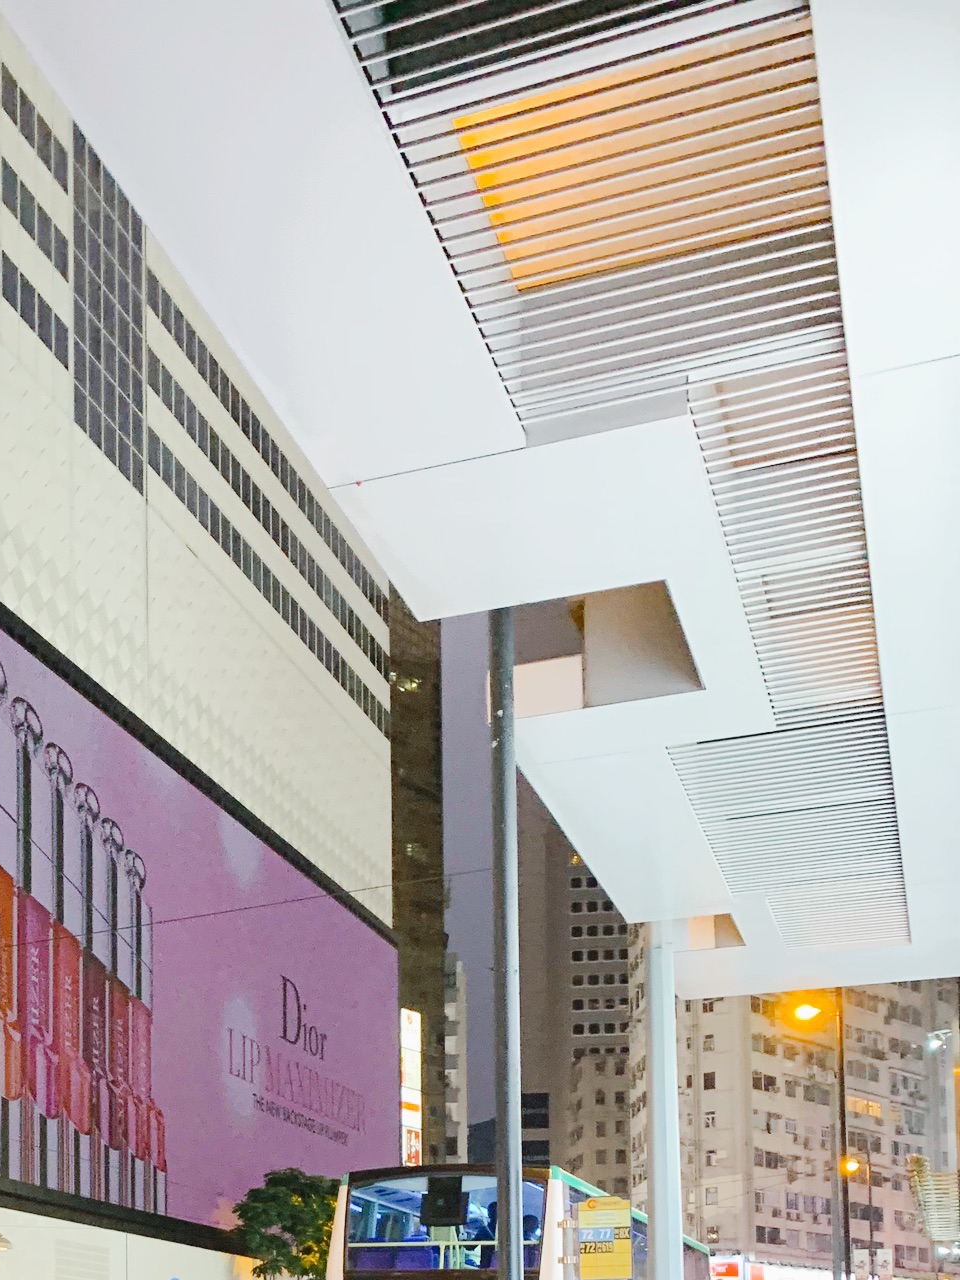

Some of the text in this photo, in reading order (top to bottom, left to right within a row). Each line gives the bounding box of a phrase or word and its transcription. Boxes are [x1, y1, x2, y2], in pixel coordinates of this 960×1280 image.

[280, 974, 328, 1060] Dior
[227, 1027, 367, 1135] LIP MAXIMIZER
[252, 1092, 265, 1113] THE
[581, 1229, 594, 1240] 72
[598, 1228, 612, 1239] 77
